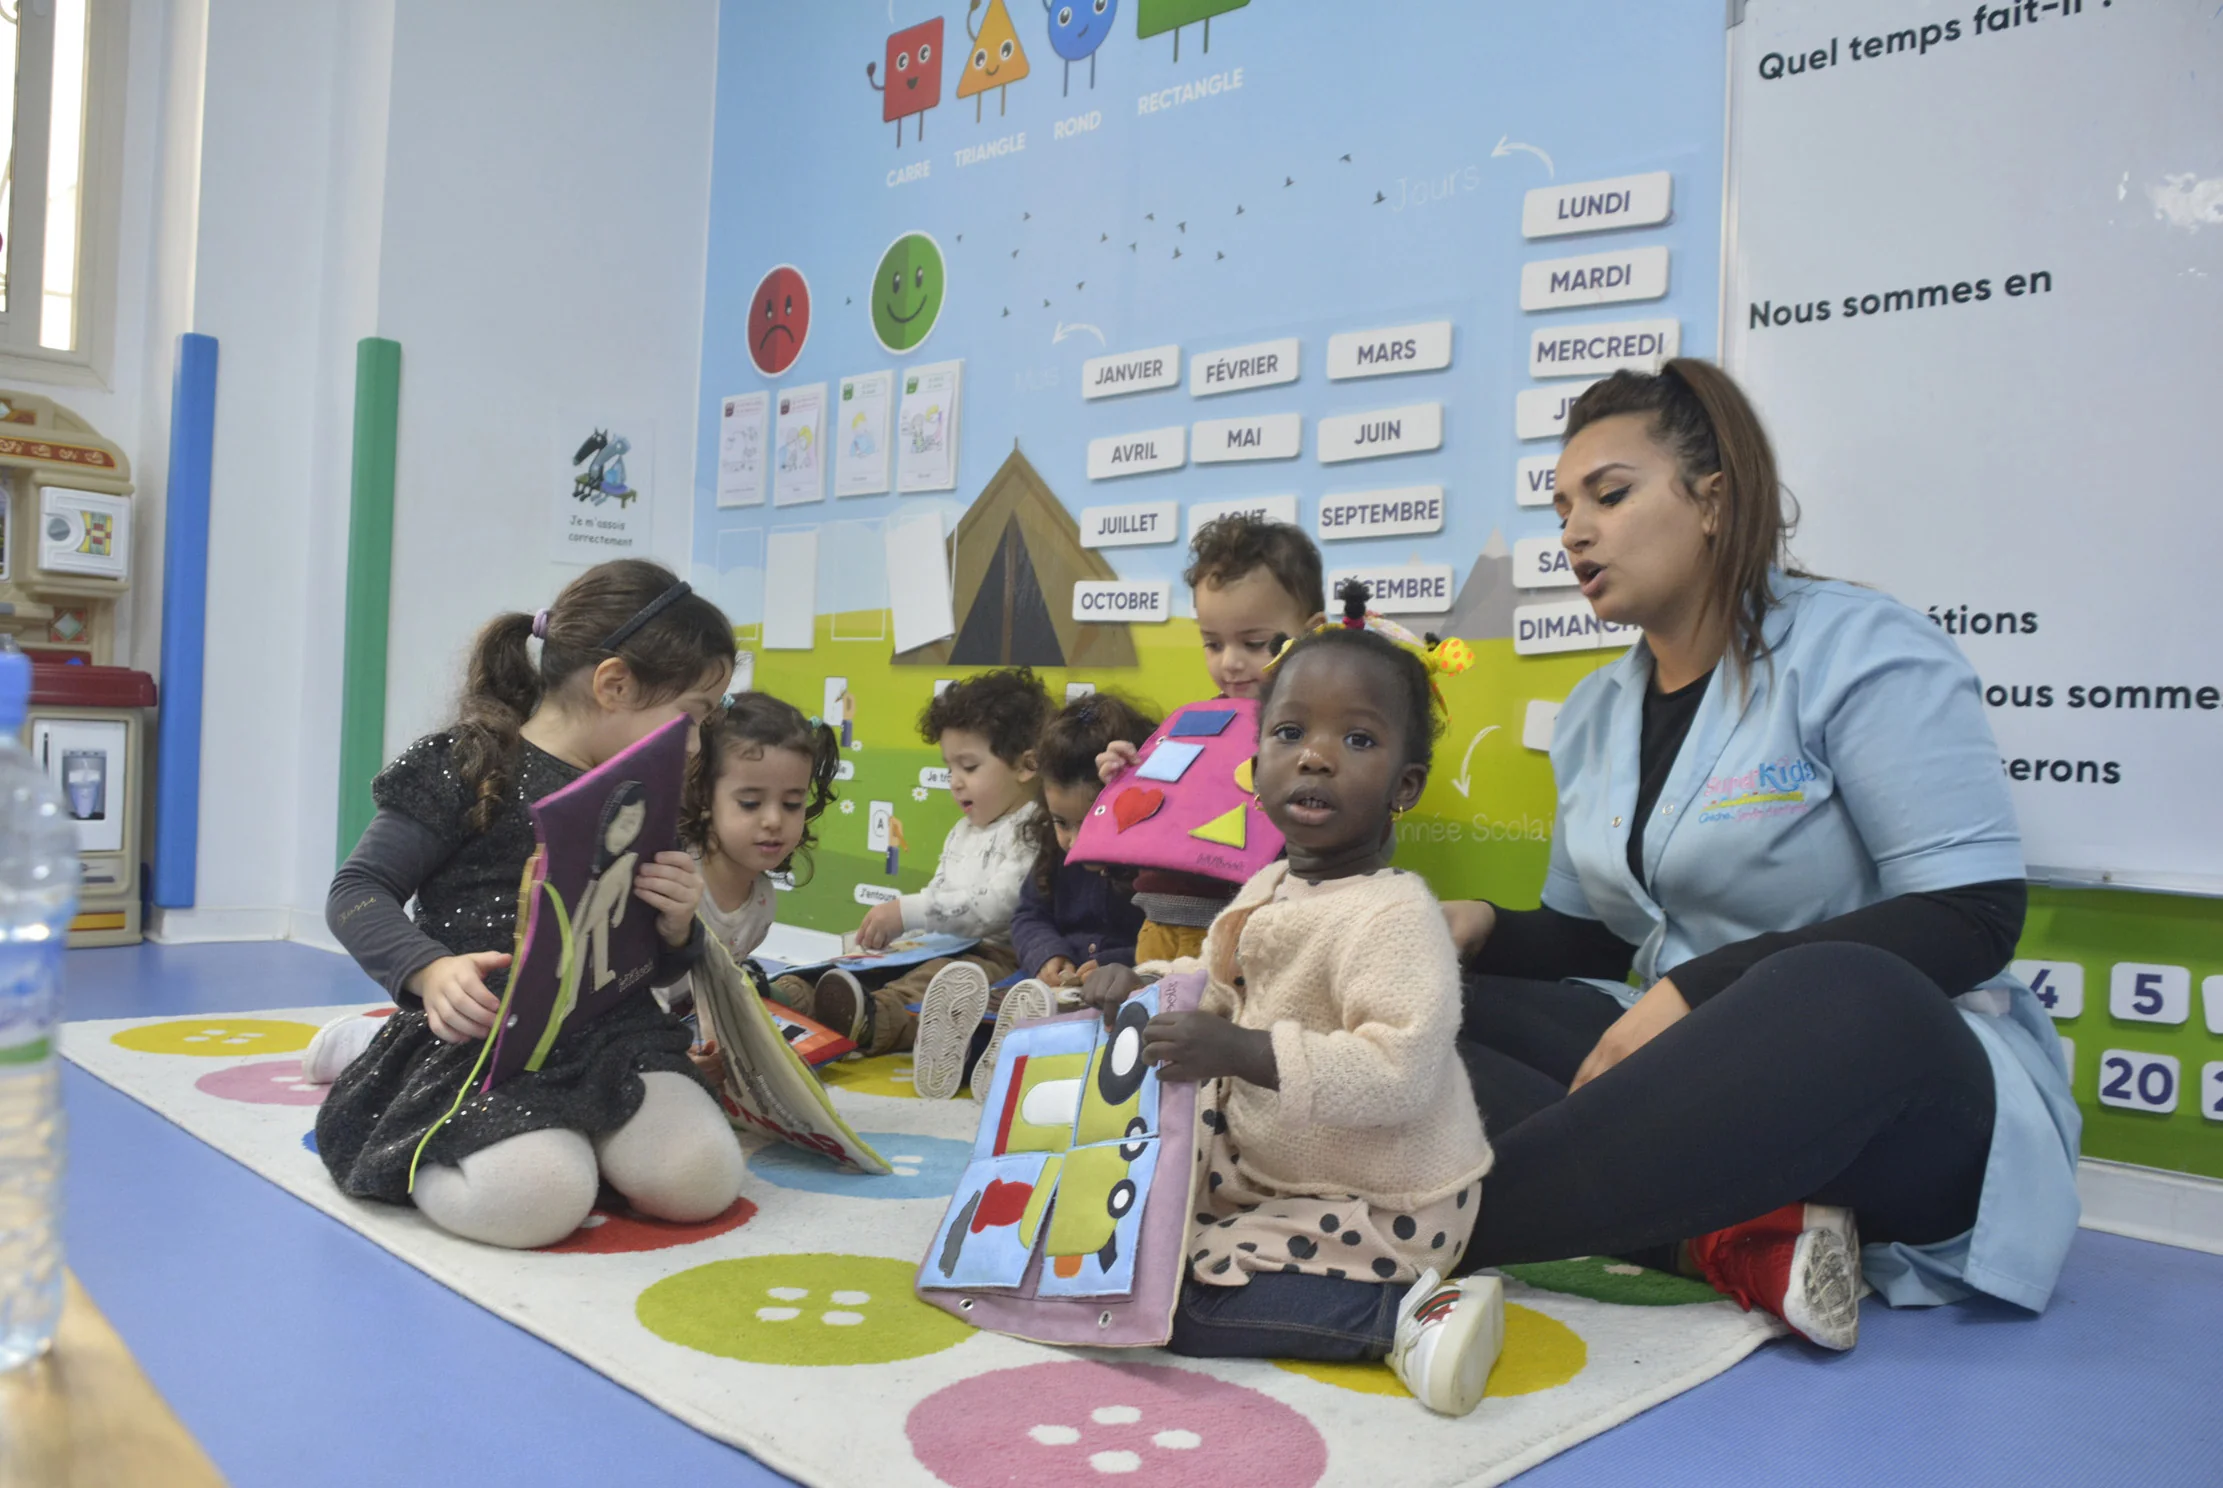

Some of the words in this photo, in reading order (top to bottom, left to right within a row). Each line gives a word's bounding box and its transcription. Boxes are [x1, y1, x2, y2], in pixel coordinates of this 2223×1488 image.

[1758, 38, 1839, 80] Quel
[1848, 18, 1961, 60] temps
[1137, 67, 1244, 116] RECTANGLE
[1053, 110, 1102, 140] ROND
[954, 132, 1027, 168] TRIANGLE
[885, 159, 932, 188] CARRE
[1391, 164, 1481, 213] Jours
[1557, 190, 1631, 220] LUNDI
[1549, 263, 1632, 293] MARDI
[1749, 299, 1832, 330] Nous
[1842, 278, 1992, 318] sommes
[2004, 270, 2053, 297] en
[1357, 338, 1417, 366] MARS
[1536, 332, 1665, 363] MERCREDI
[1094, 358, 1164, 386] JANVIER
[1205, 353, 1279, 384] FÉVRIER
[1226, 427, 1262, 449] MAI
[1353, 419, 1402, 445] JUIN
[1110, 441, 1158, 464] AVRIL
[569, 514, 583, 526] Je
[585, 516, 626, 530] m'assois
[1097, 512, 1158, 535] JUILLET
[1321, 499, 1440, 527] SEPTEMBRE
[568, 533, 633, 547] correctement
[1081, 591, 1160, 610] OCTOBRE
[2066, 684, 2223, 710] somme
[927, 771, 938, 782] Je
[877, 817, 884, 829] A
[1395, 811, 1463, 842] nnée
[2029, 968, 2059, 1010] 4
[2131, 972, 2165, 1016] 5
[2101, 1056, 2174, 1106] 20
